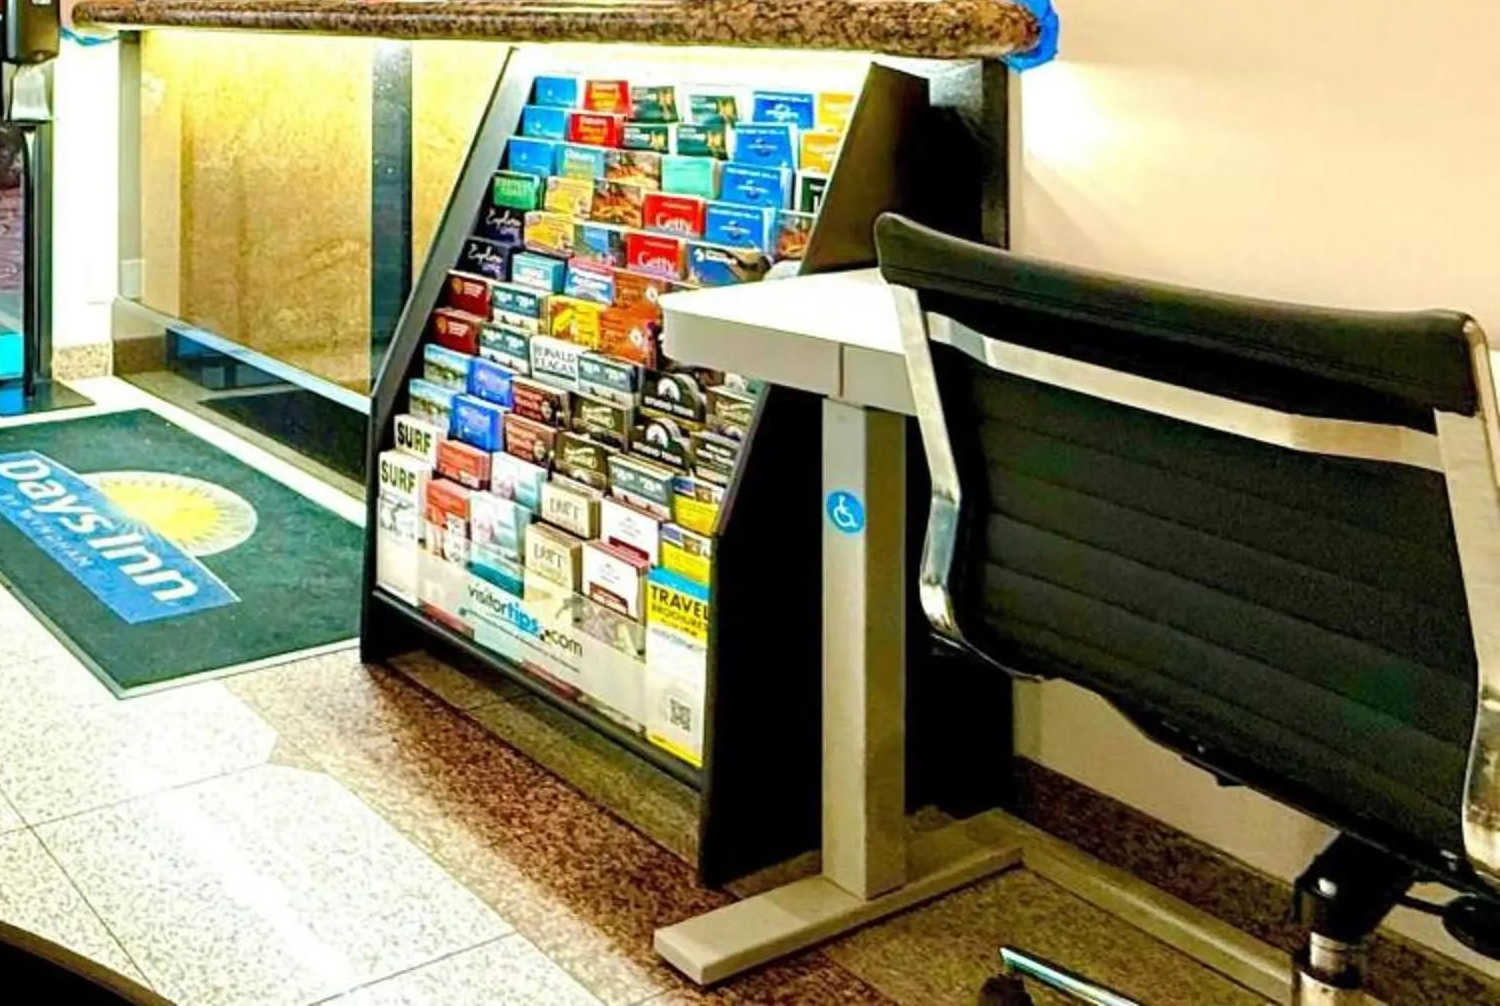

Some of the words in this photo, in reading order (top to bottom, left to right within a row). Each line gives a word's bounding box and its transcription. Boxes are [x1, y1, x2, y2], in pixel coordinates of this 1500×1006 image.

[396, 421, 432, 455] SURF
[381, 459, 417, 495] SURF
[87, 533, 199, 602] Inn
[650, 584, 708, 621] TRAVEL
